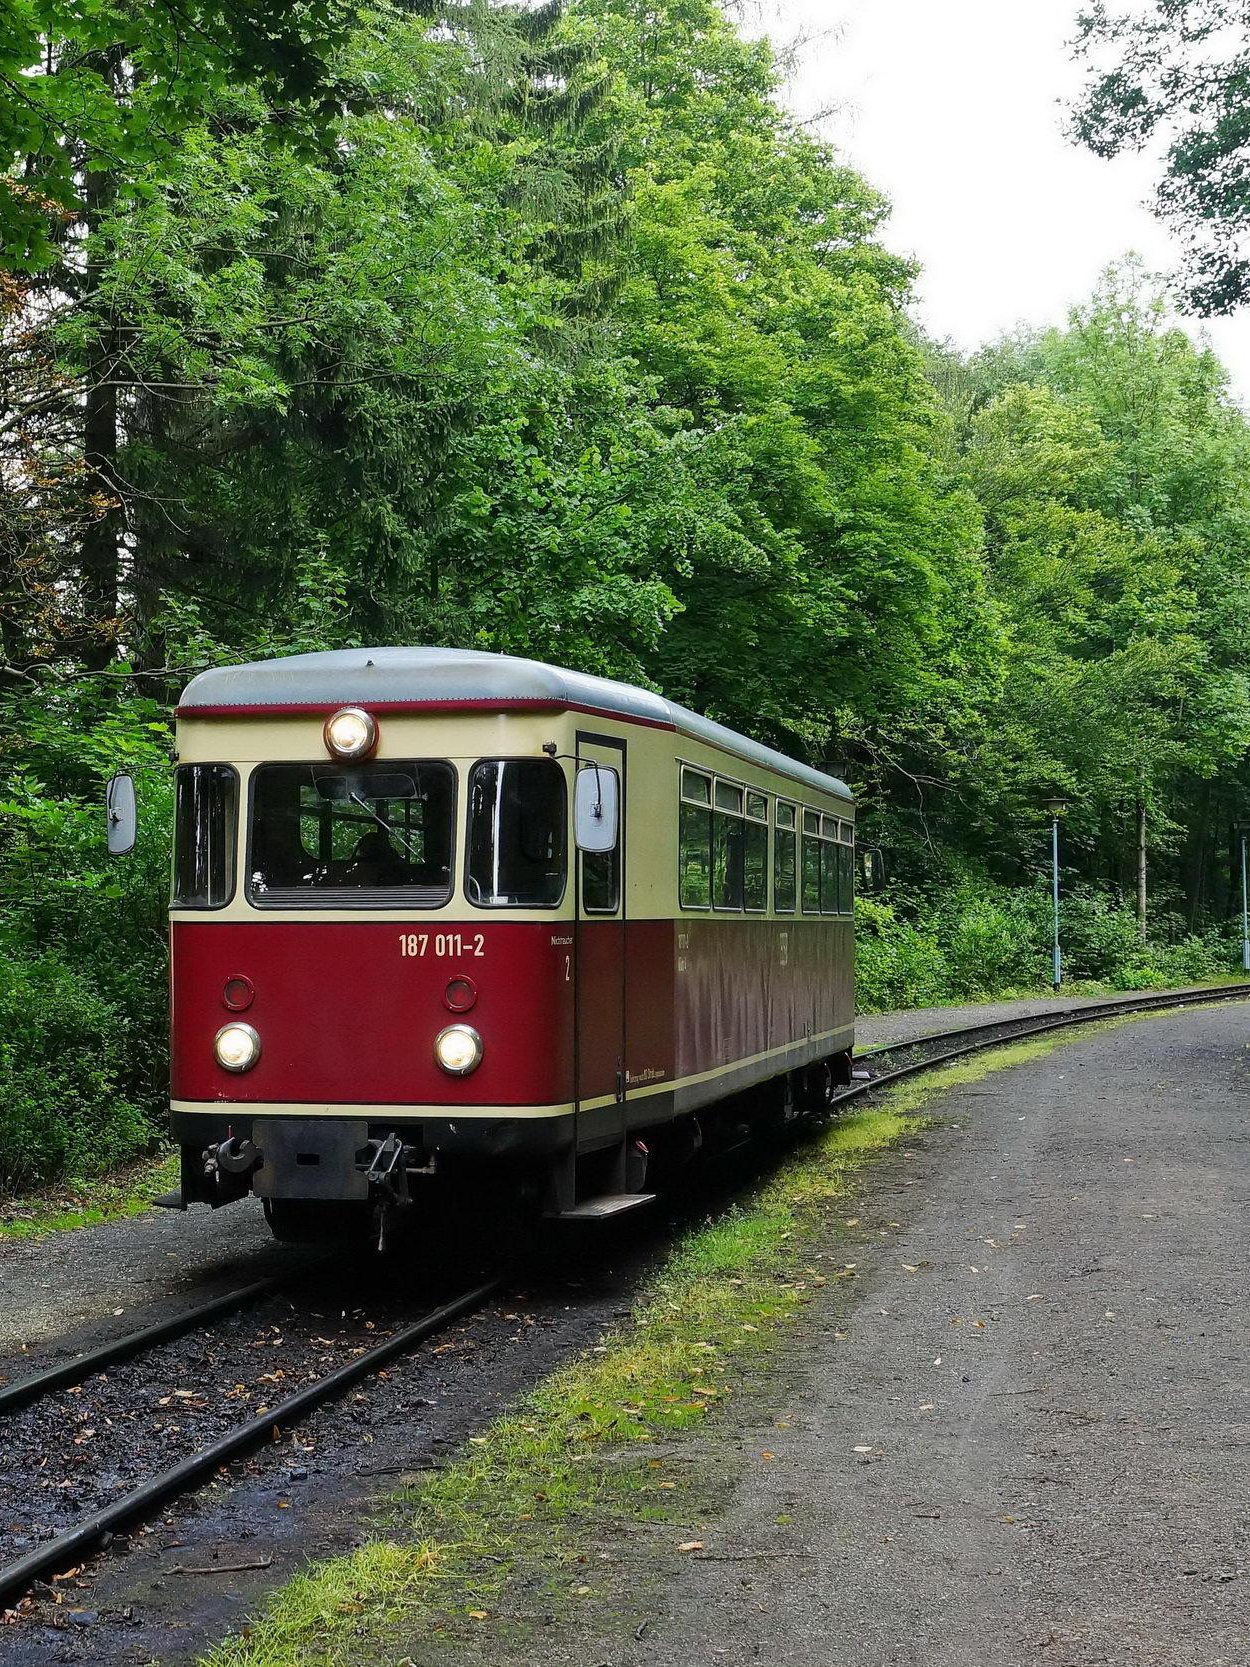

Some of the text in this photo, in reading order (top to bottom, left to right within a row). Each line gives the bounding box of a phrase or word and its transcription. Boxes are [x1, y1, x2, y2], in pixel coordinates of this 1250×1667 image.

[399, 934, 485, 957] 187 011-2
[565, 955, 570, 981] 2
